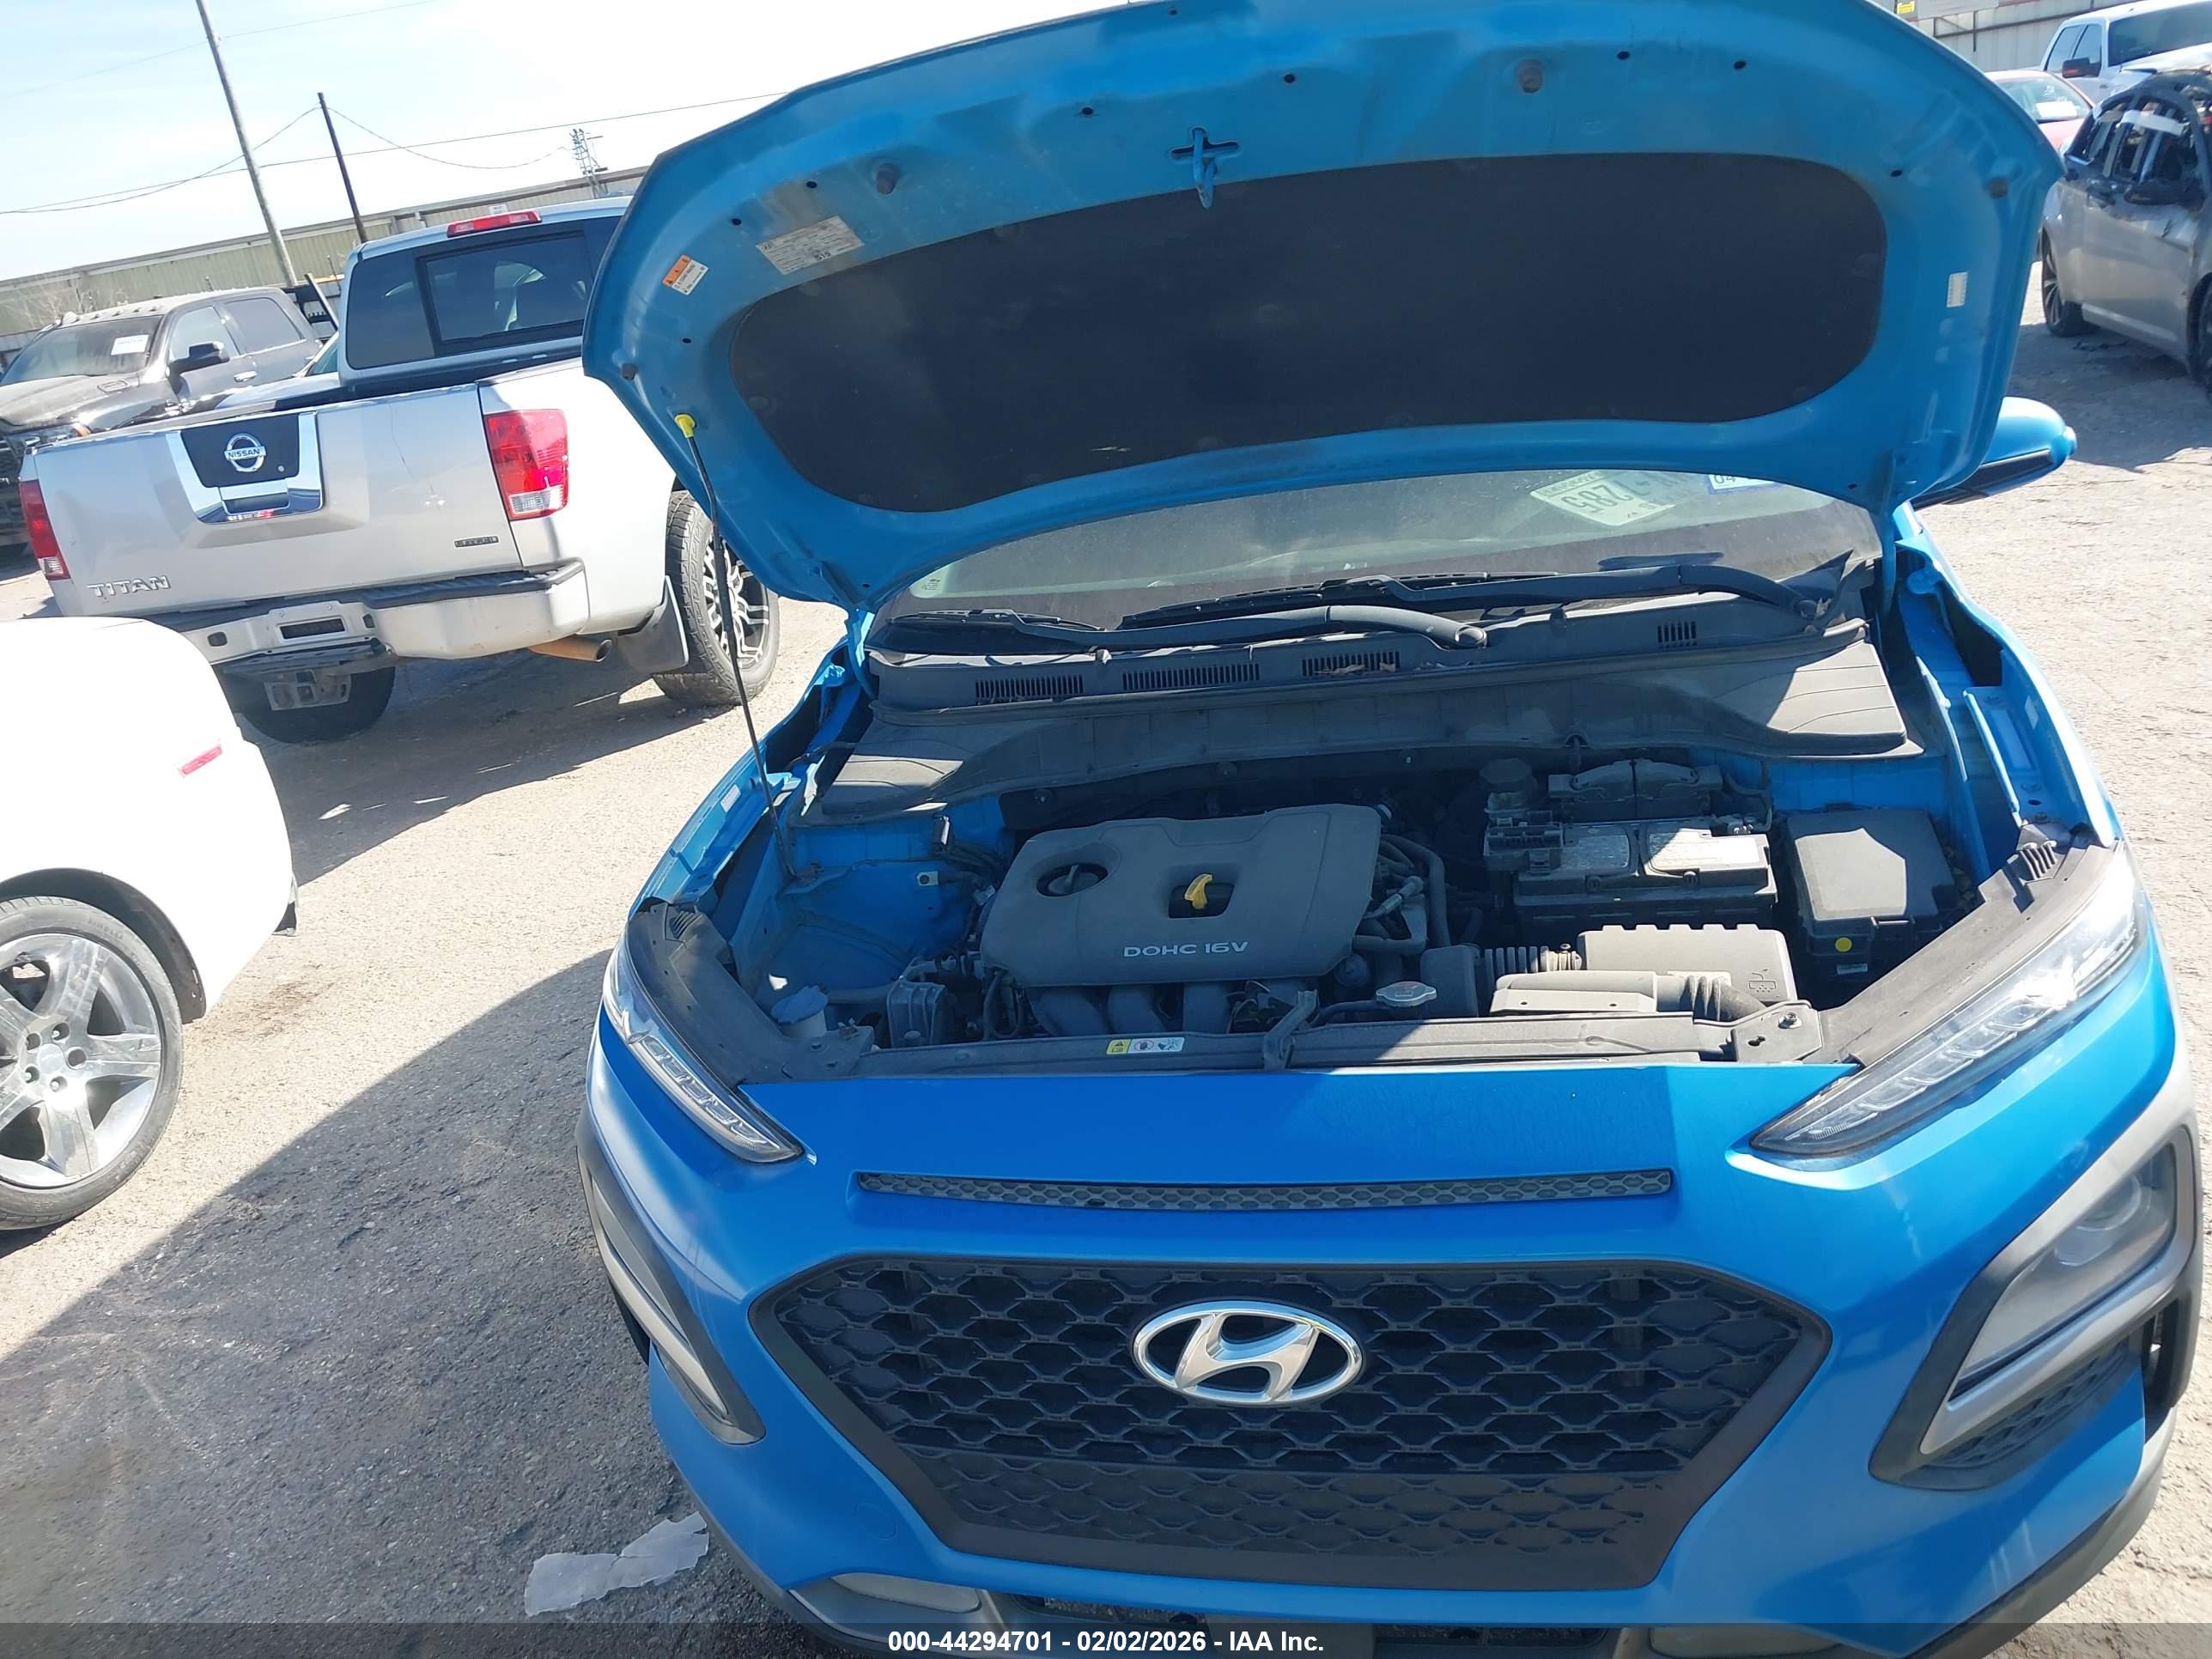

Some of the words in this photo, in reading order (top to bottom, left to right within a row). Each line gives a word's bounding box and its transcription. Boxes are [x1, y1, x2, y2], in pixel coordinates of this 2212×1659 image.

[228, 447, 260, 459] NISSAN
[86, 574, 171, 598] TITAN
[1123, 944, 1197, 957] DOHC
[1204, 941, 1249, 954] 16V
